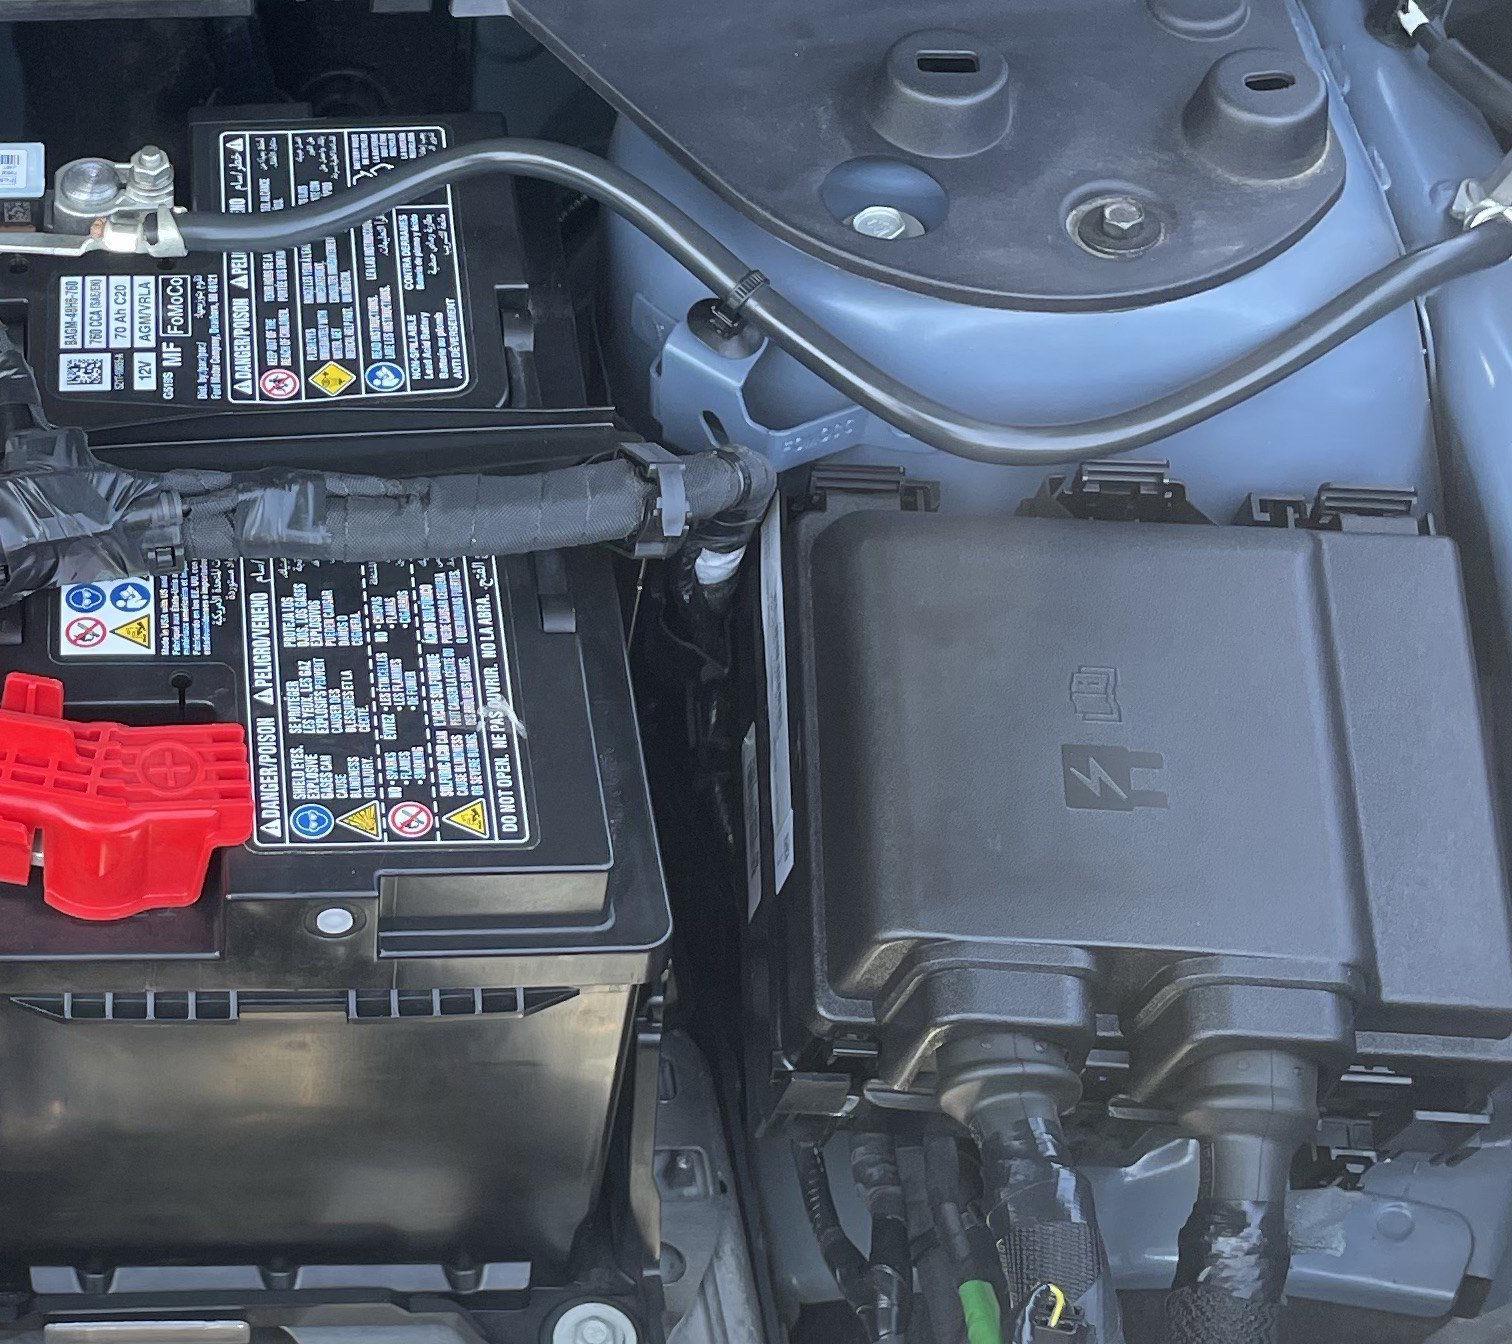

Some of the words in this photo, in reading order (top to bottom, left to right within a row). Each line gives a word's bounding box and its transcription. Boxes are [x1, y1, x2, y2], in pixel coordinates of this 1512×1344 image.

[399, 214, 411, 256] DERRAMES
[401, 257, 414, 290] CONTRA
[115, 285, 126, 305] C20
[138, 282, 151, 342] AGM/VRLA
[166, 277, 184, 334] FoMoCo
[90, 310, 102, 327] CCA
[115, 309, 126, 323] Ah
[420, 312, 431, 340] Battery
[90, 330, 102, 344] 760
[115, 327, 126, 338] 70
[232, 298, 252, 379] DANGER/POISON
[383, 333, 394, 343] LES
[162, 342, 182, 366] MF
[407, 315, 421, 379] NON-SPILLABLE
[139, 361, 151, 381] 12V
[210, 365, 221, 383] Motor
[424, 360, 434, 379] Lead
[451, 359, 462, 379] ANTI
[211, 384, 221, 399] Ford
[160, 589, 168, 598] US
[293, 583, 307, 607] GASES
[322, 590, 335, 617] CAUSAR
[281, 597, 294, 611] LOS
[476, 594, 493, 625] ABRA.
[160, 614, 169, 628] USA
[295, 608, 308, 623] LOS
[309, 600, 323, 647] EXPLOSIVOS
[250, 592, 273, 687] PELIGRO/VENENO
[282, 612, 296, 647] PROTEJA
[296, 625, 309, 647] OJOS.
[324, 619, 337, 646] PUEDEN
[374, 632, 388, 642] NO
[479, 627, 494, 640] LA
[481, 643, 496, 658] NO
[298, 660, 311, 676] GAZ
[313, 657, 326, 689] PEUVENT
[341, 670, 353, 680] LA
[390, 659, 403, 691] FLAMMES
[300, 678, 312, 692] LES
[342, 681, 354, 690] ET
[446, 678, 458, 686] LA
[483, 664, 503, 711] OUVRIR.
[284, 681, 301, 722] PROTÉGER
[329, 689, 341, 703] DES
[380, 693, 392, 706] LES
[393, 693, 405, 705] LES
[407, 696, 419, 705] DE
[314, 691, 329, 734] EXPLOSIFS
[329, 704, 343, 734] CAUSER
[342, 691, 357, 733] BLESSURES
[488, 712, 505, 731] PAS
[289, 724, 302, 733] SE
[302, 719, 316, 733] LES
[436, 730, 448, 743] CAN
[492, 733, 510, 748] NE
[290, 745, 304, 769] EYES.
[319, 755, 332, 770] CAN
[385, 752, 399, 779] SPARKS
[398, 751, 412, 779] FLAMES
[412, 746, 426, 779] SMOKING
[257, 717, 280, 818] DANGER/POISON
[305, 754, 320, 799] EXPLOSIVE
[347, 756, 362, 798] BLINDNESS
[362, 756, 374, 785] INJURY.
[494, 754, 512, 787] OPEN.
[292, 771, 306, 799] SHIELD
[320, 772, 334, 799] GASES
[335, 774, 348, 798] CAUSE
[364, 787, 376, 798] OR
[388, 787, 402, 798] NO
[471, 785, 484, 795] OR
[498, 790, 516, 812] NOT
[501, 815, 518, 832] DO
